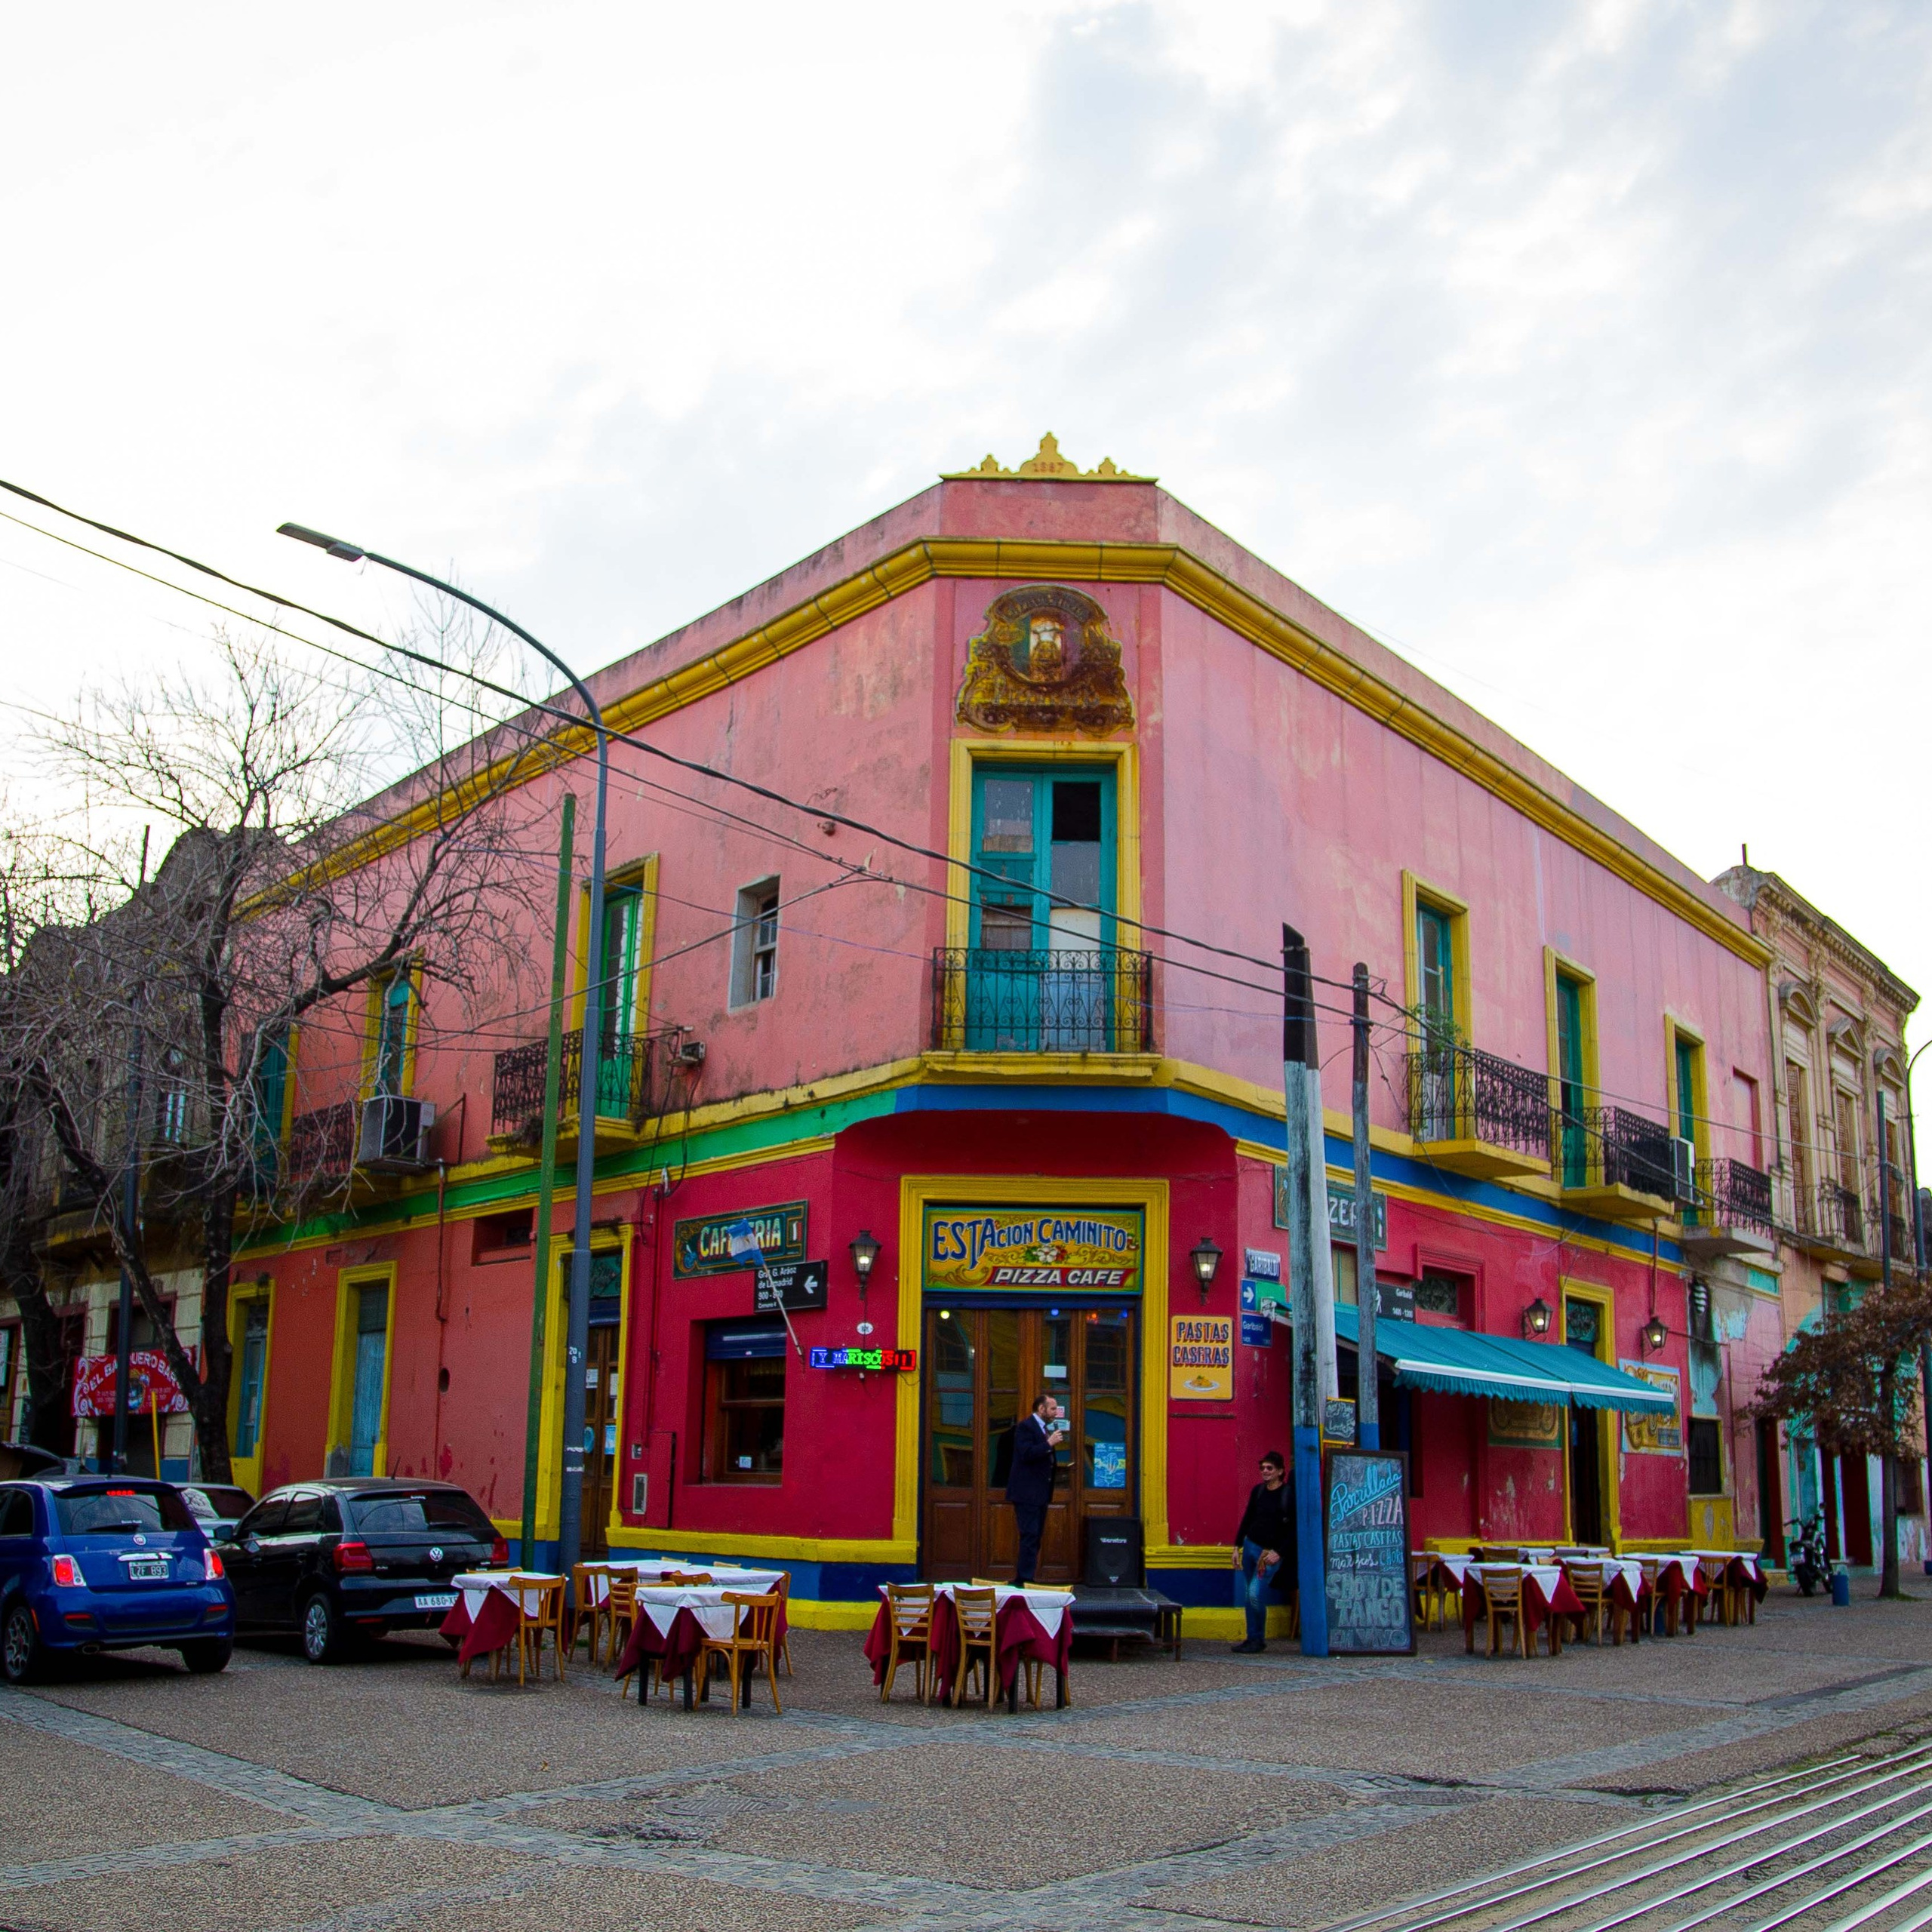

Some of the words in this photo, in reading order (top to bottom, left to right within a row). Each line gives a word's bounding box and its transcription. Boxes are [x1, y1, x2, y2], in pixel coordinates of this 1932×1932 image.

[1038, 1217, 1128, 1252] CAMINITO
[1251, 1255, 1279, 1277] GARIBALDI
[758, 1280, 765, 1289] de
[994, 1268, 1062, 1284] PIZZA
[1066, 1269, 1126, 1285] CAFE
[1177, 1321, 1229, 1341] PASTAS
[819, 1352, 828, 1364] Y
[1173, 1346, 1230, 1366] CASERAS
[89, 1373, 104, 1391] EL
[1331, 1463, 1403, 1528] Parrillada
[1362, 1496, 1404, 1526] PIZZA
[1333, 1531, 1361, 1549] PASTAS
[1363, 1531, 1403, 1546] CASERAS
[1326, 1574, 1380, 1599] SHOW
[1381, 1577, 1405, 1598] DE
[418, 1598, 428, 1606] AA
[1335, 1599, 1405, 1629] TANGO
[1329, 1629, 1353, 1647] EN
[1355, 1629, 1407, 1647] VIVO
